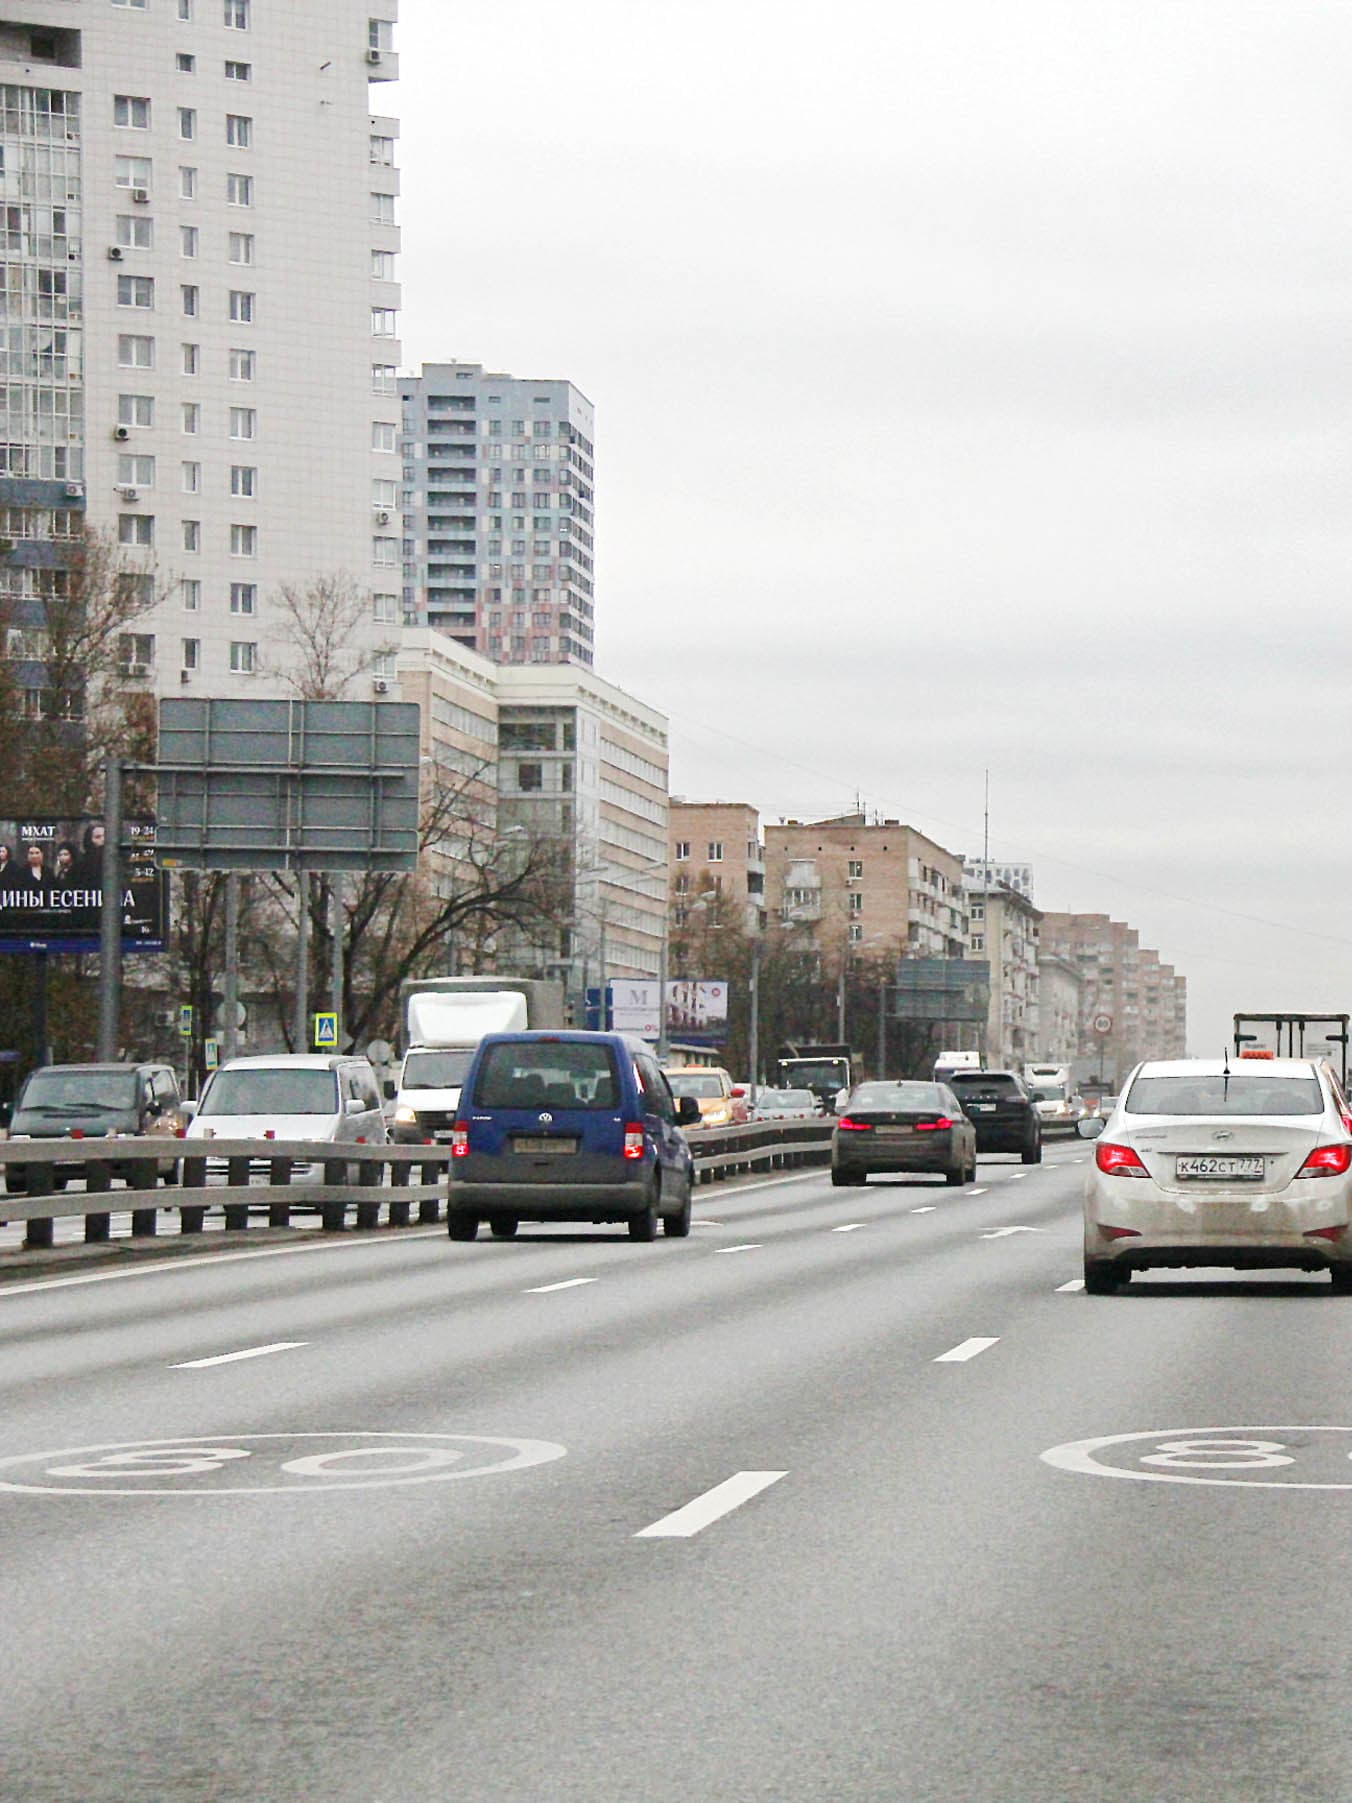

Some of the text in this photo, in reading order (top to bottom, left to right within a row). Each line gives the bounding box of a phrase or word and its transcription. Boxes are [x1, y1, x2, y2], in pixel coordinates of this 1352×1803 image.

[22, 825, 56, 837] МХАТ
[0, 889, 135, 909] ИНЫ ЕСЕНА
[45, 1446, 466, 1478] 80
